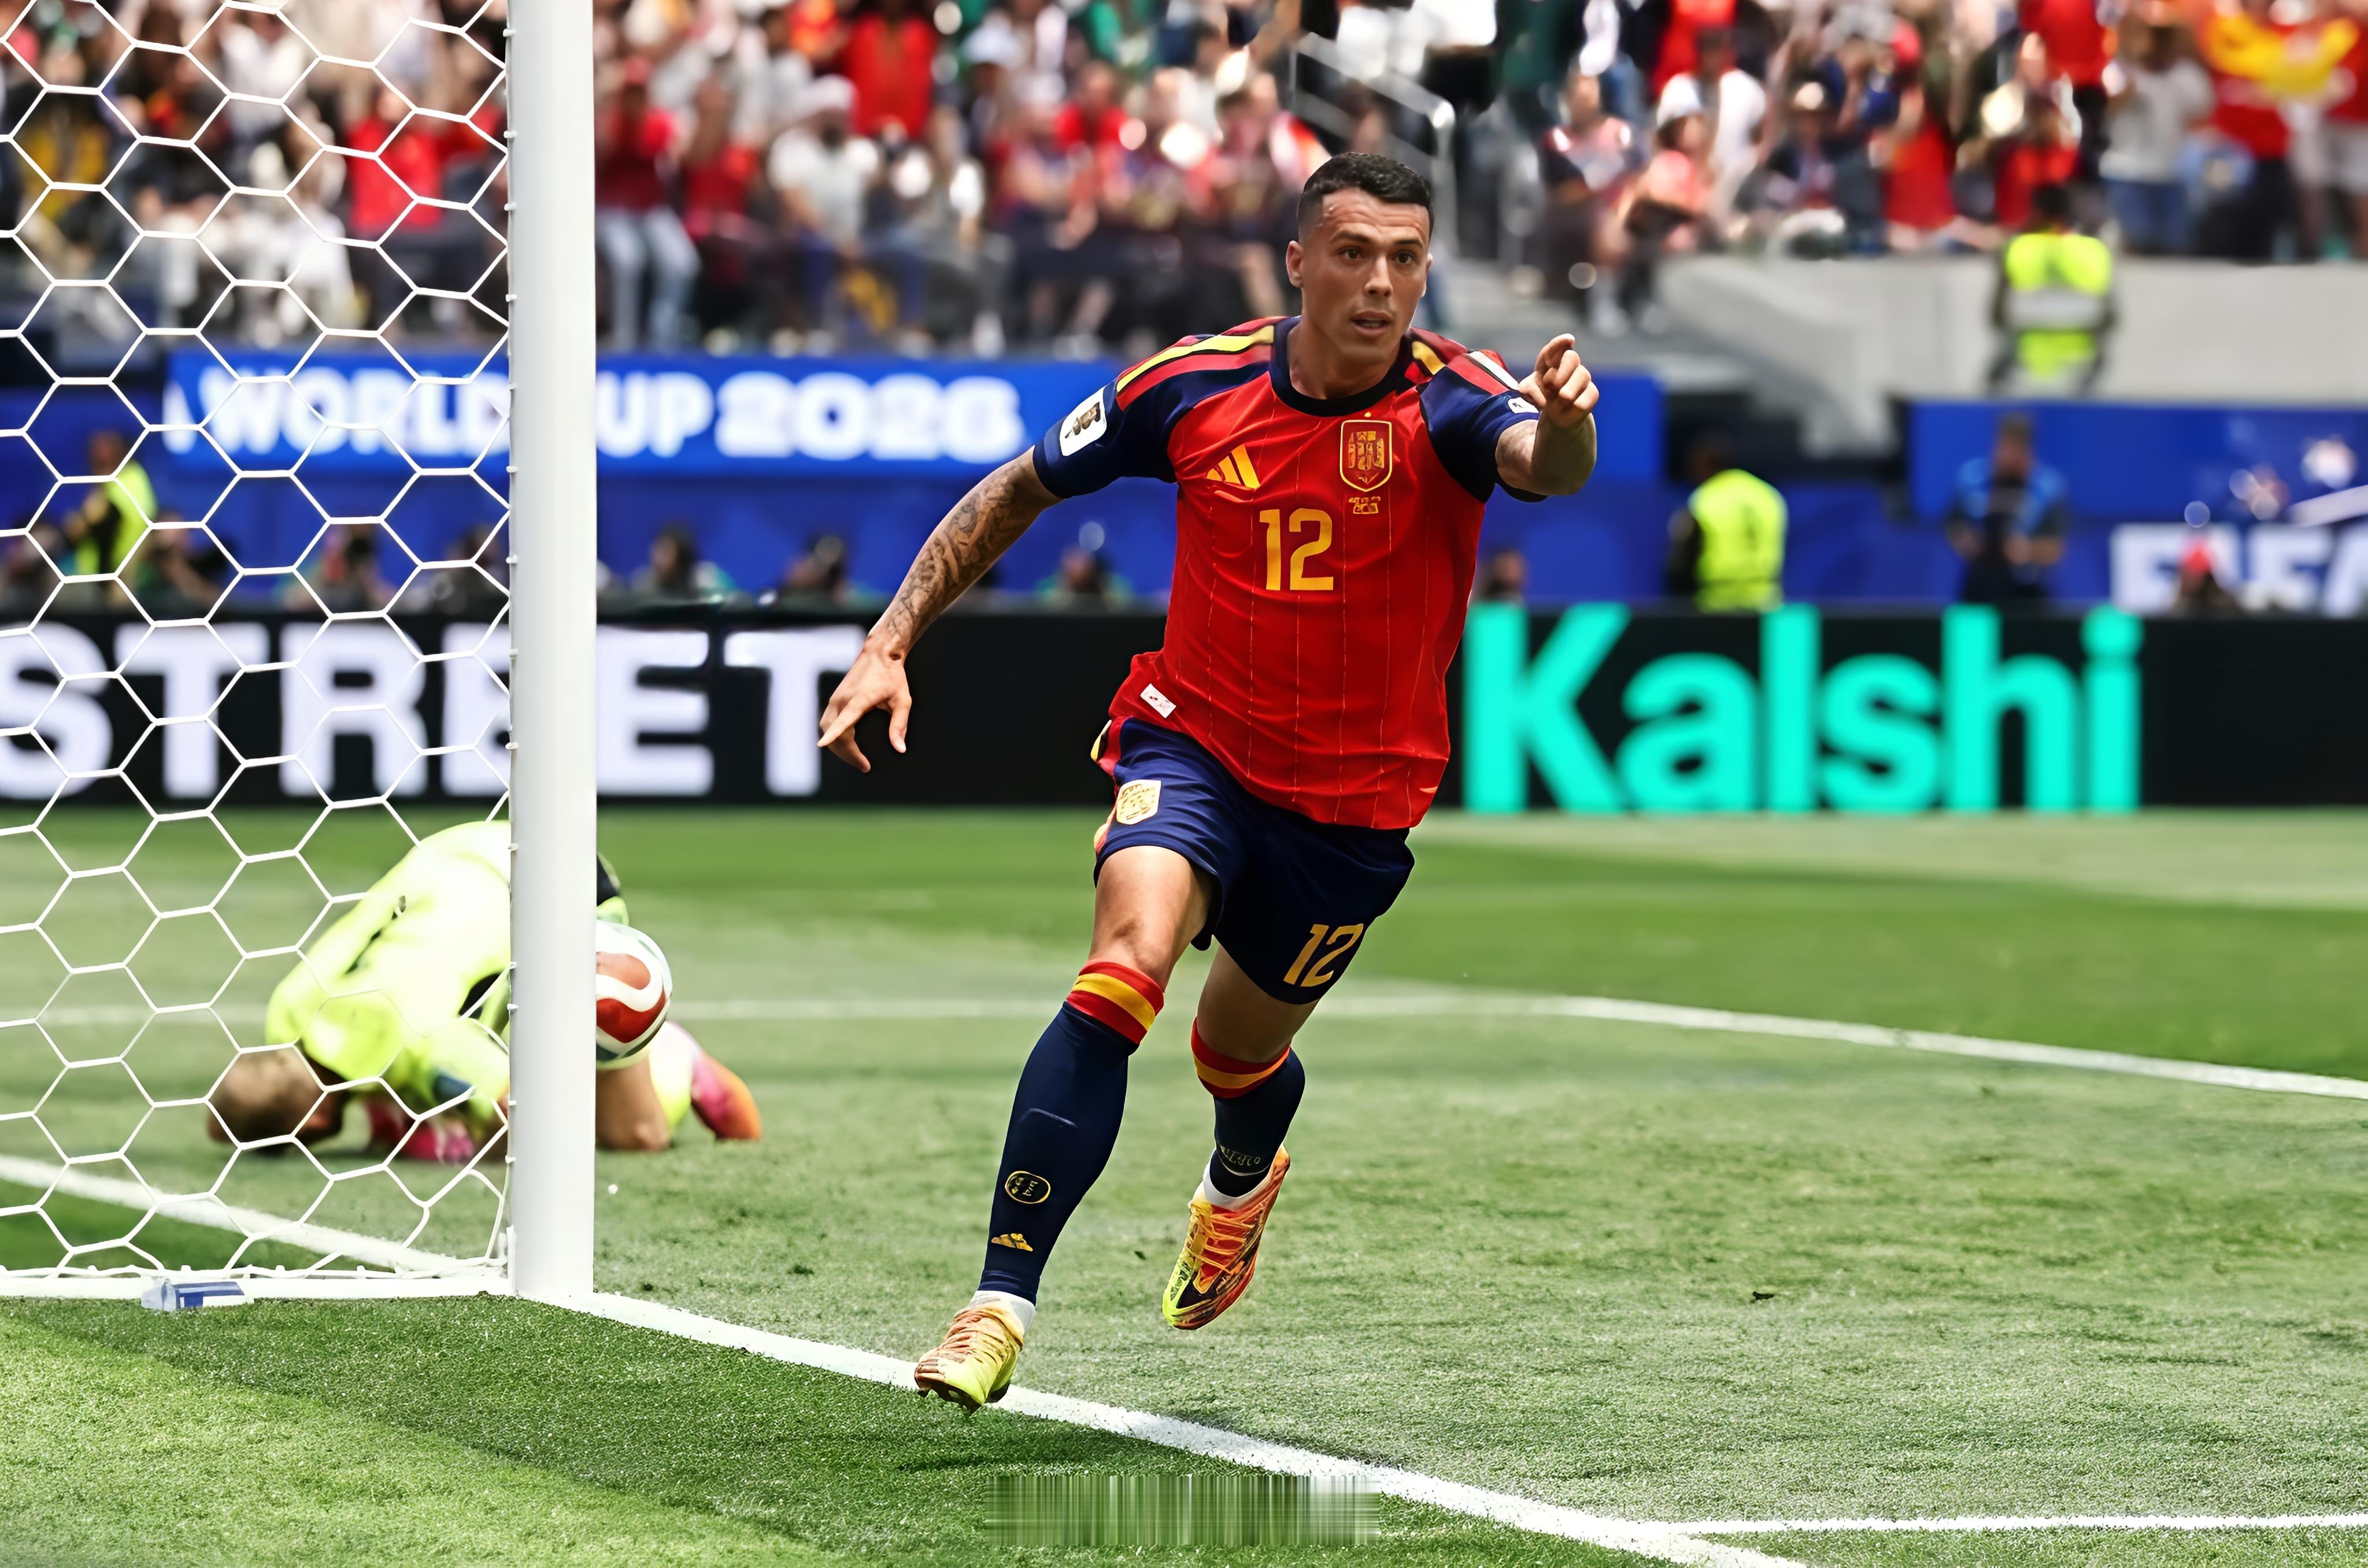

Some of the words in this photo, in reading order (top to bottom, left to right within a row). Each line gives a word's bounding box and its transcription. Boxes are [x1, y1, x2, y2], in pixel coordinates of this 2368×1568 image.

[199, 366, 510, 456] WORLD
[596, 370, 715, 457] UP
[1259, 508, 1334, 591] 12
[1464, 603, 2144, 816] Kalshi
[1283, 923, 1364, 987] 12
